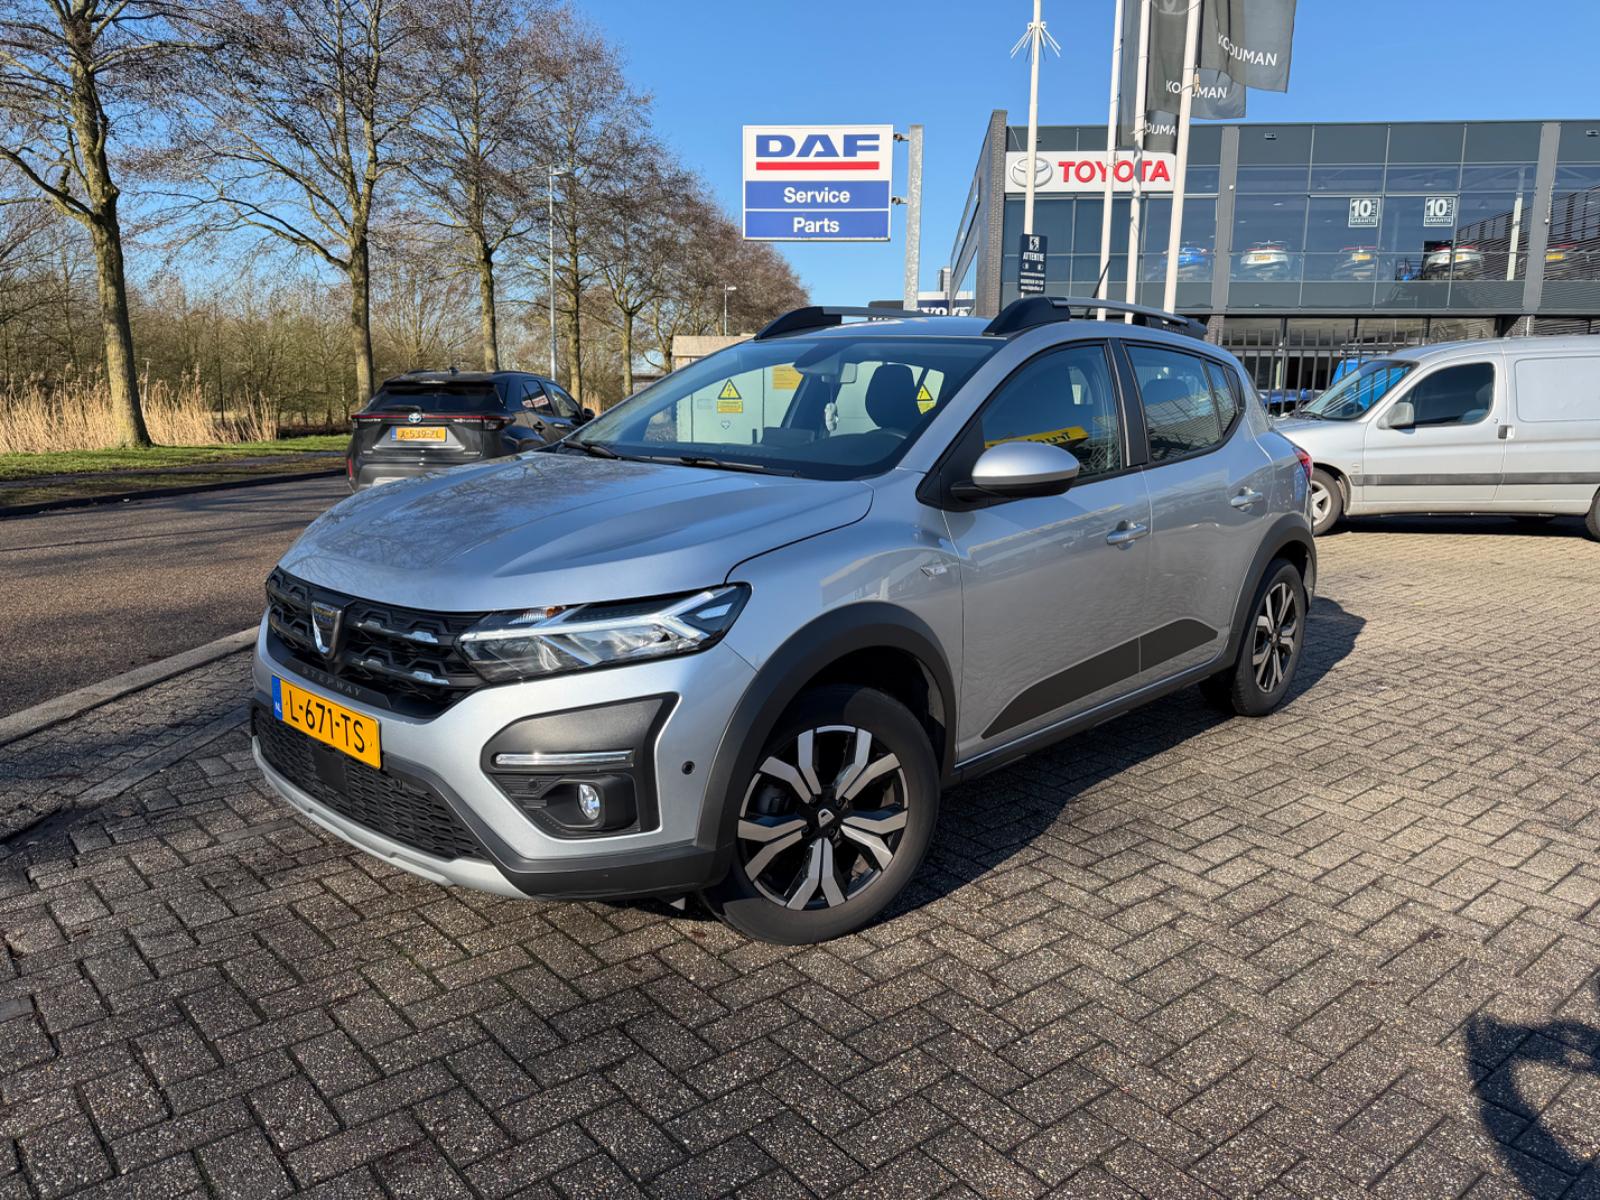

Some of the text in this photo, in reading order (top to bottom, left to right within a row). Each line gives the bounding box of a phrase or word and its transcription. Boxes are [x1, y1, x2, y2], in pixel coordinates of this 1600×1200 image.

[756, 134, 880, 157] DAF
[1058, 160, 1170, 183] TOYOTA
[784, 187, 850, 203] Service
[1351, 200, 1372, 217] 10
[1427, 199, 1448, 216] 10
[793, 217, 840, 232] Parts
[303, 668, 361, 695] STEPWAY
[289, 690, 365, 753] L-671-TS
